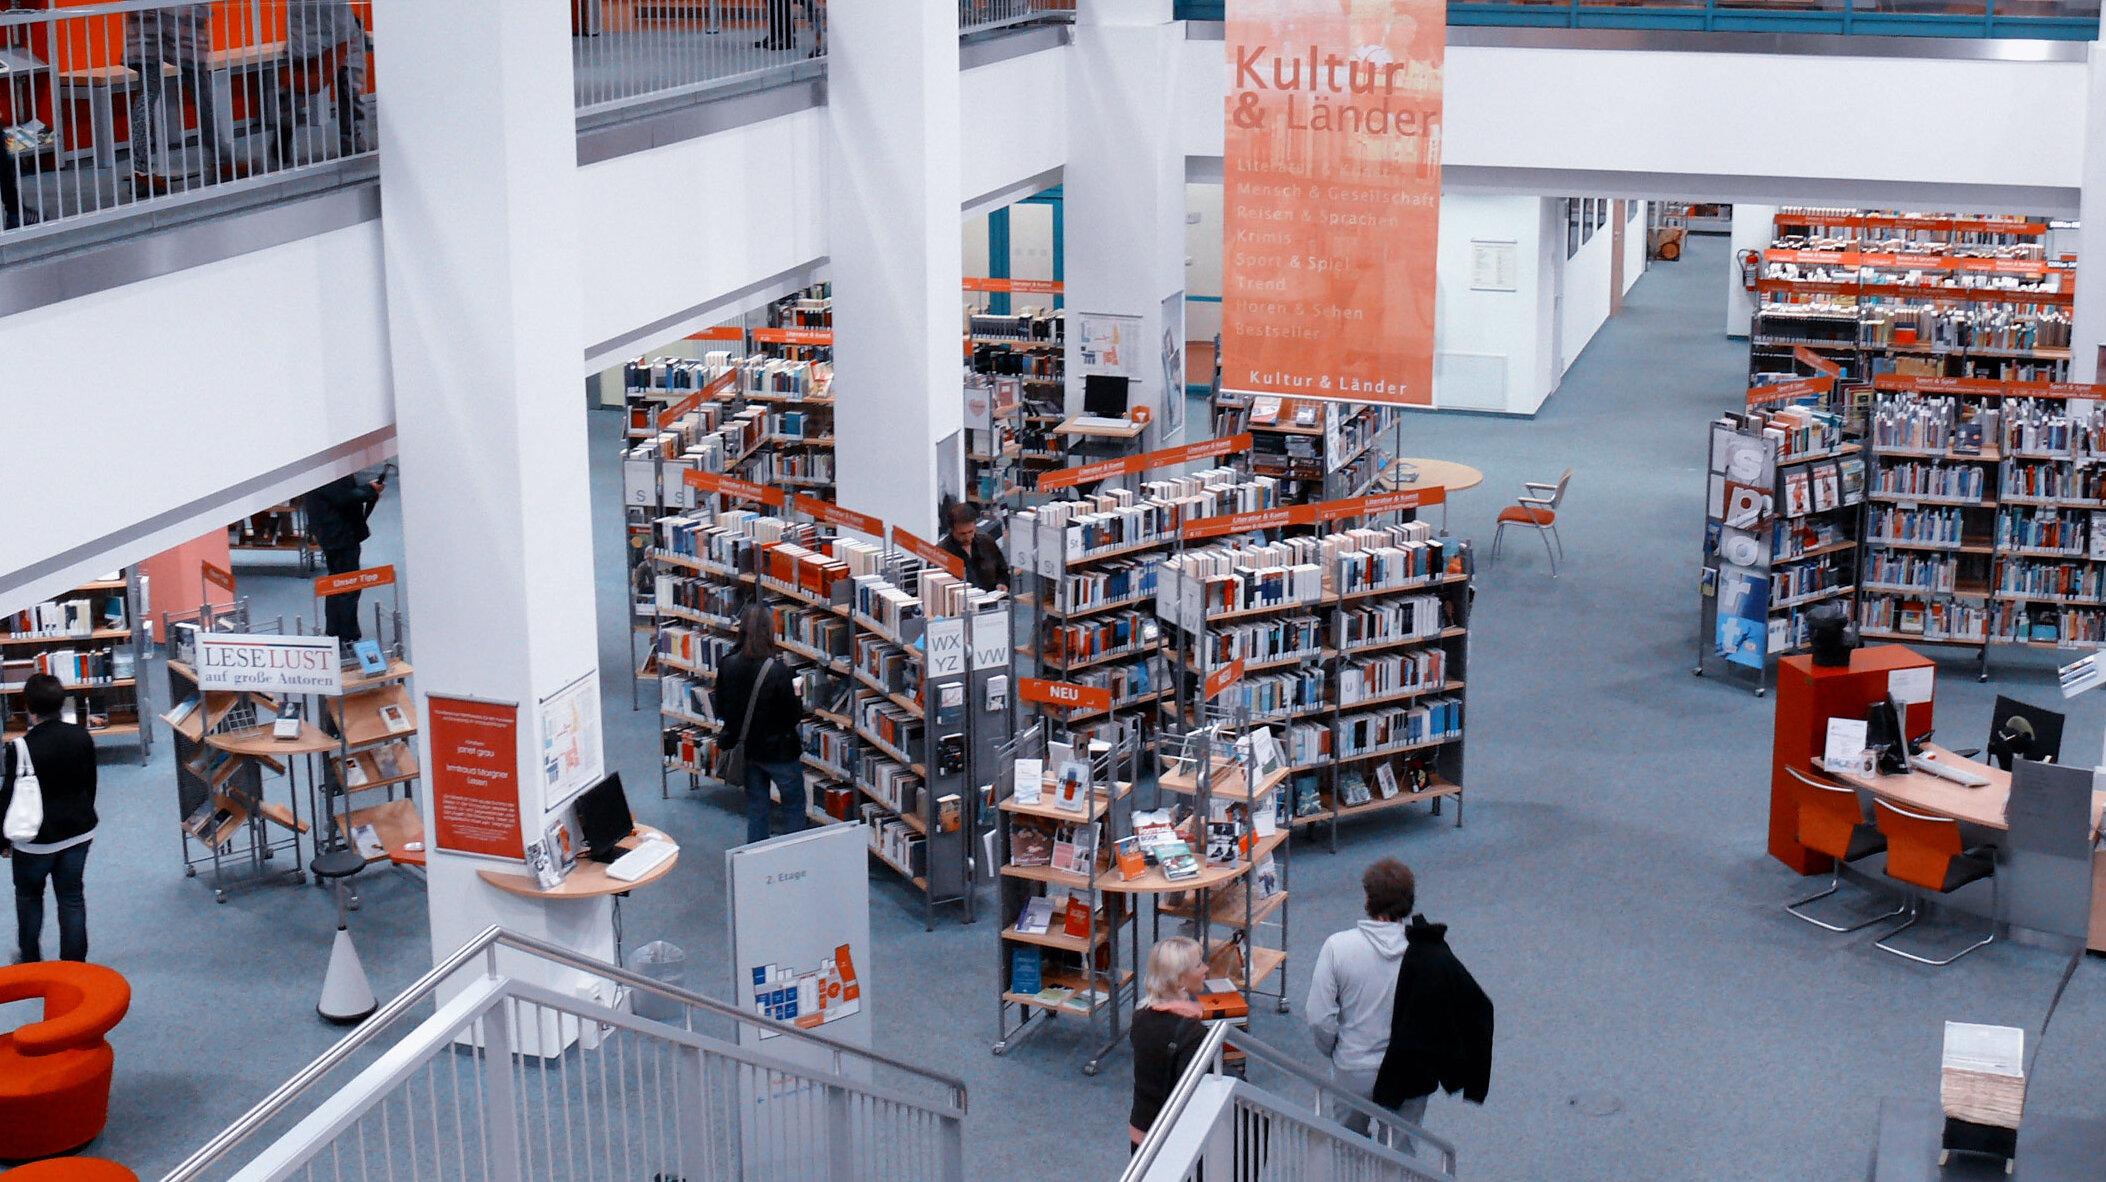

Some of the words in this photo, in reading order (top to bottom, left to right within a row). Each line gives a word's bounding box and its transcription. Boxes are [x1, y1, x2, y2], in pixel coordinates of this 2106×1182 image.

[1236, 45, 1404, 95] Kultur
[1232, 91, 1265, 129] &
[1287, 94, 1437, 136] Länder
[1236, 182, 1301, 198] Mensch
[1309, 185, 1320, 199] &
[1328, 186, 1434, 208] Gesellschaft
[1237, 205, 1294, 221] Reisen
[1321, 210, 1398, 227] Sprachen
[1236, 229, 1292, 245] Krimis
[1236, 252, 1281, 268] Sport
[1290, 255, 1300, 268] &
[1308, 256, 1350, 272] Spiel
[1236, 276, 1286, 291] Trend
[1236, 322, 1320, 340] Bestseller
[1249, 370, 1313, 388] Kultur
[1319, 375, 1331, 389] &
[1340, 378, 1407, 396] Länder
[636, 490, 646, 502] S
[675, 491, 684, 504] S
[1018, 552, 1025, 565] S
[333, 577, 357, 587] Unser
[359, 573, 378, 583] Tipp
[932, 633, 961, 651] WX
[205, 646, 333, 670] LESELUST
[935, 655, 958, 672] YZ
[978, 647, 1005, 665] VW
[205, 671, 227, 682] auf
[234, 674, 272, 685] große
[278, 673, 333, 687] Autoren
[1345, 682, 1352, 692] U
[1050, 685, 1079, 701] NEU
[766, 876, 775, 885] 2.
[778, 869, 807, 882] Etage
